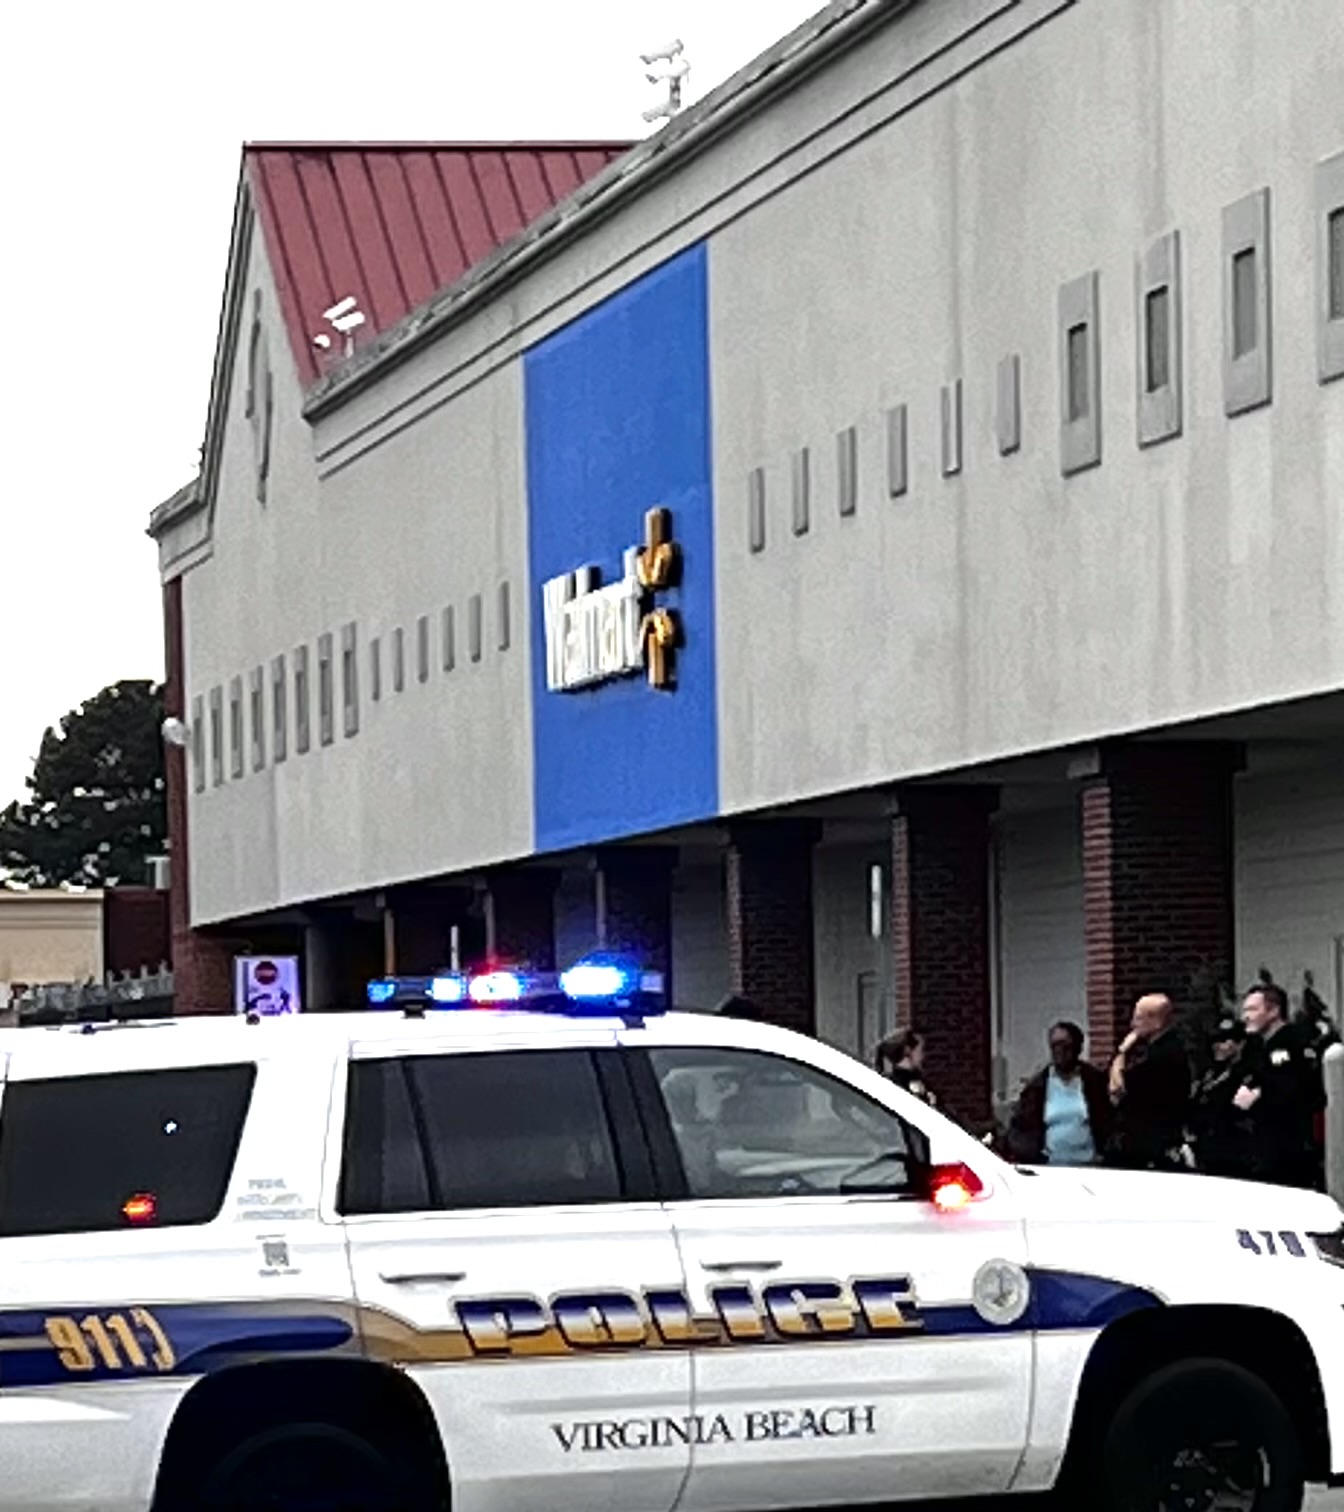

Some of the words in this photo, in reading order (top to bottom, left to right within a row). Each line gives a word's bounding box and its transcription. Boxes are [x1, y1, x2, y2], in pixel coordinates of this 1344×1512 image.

[43, 1312, 147, 1372] 911
[450, 1274, 924, 1357] POLICE
[550, 1412, 734, 1452] VIRGINIA
[743, 1405, 877, 1442] BEACH
